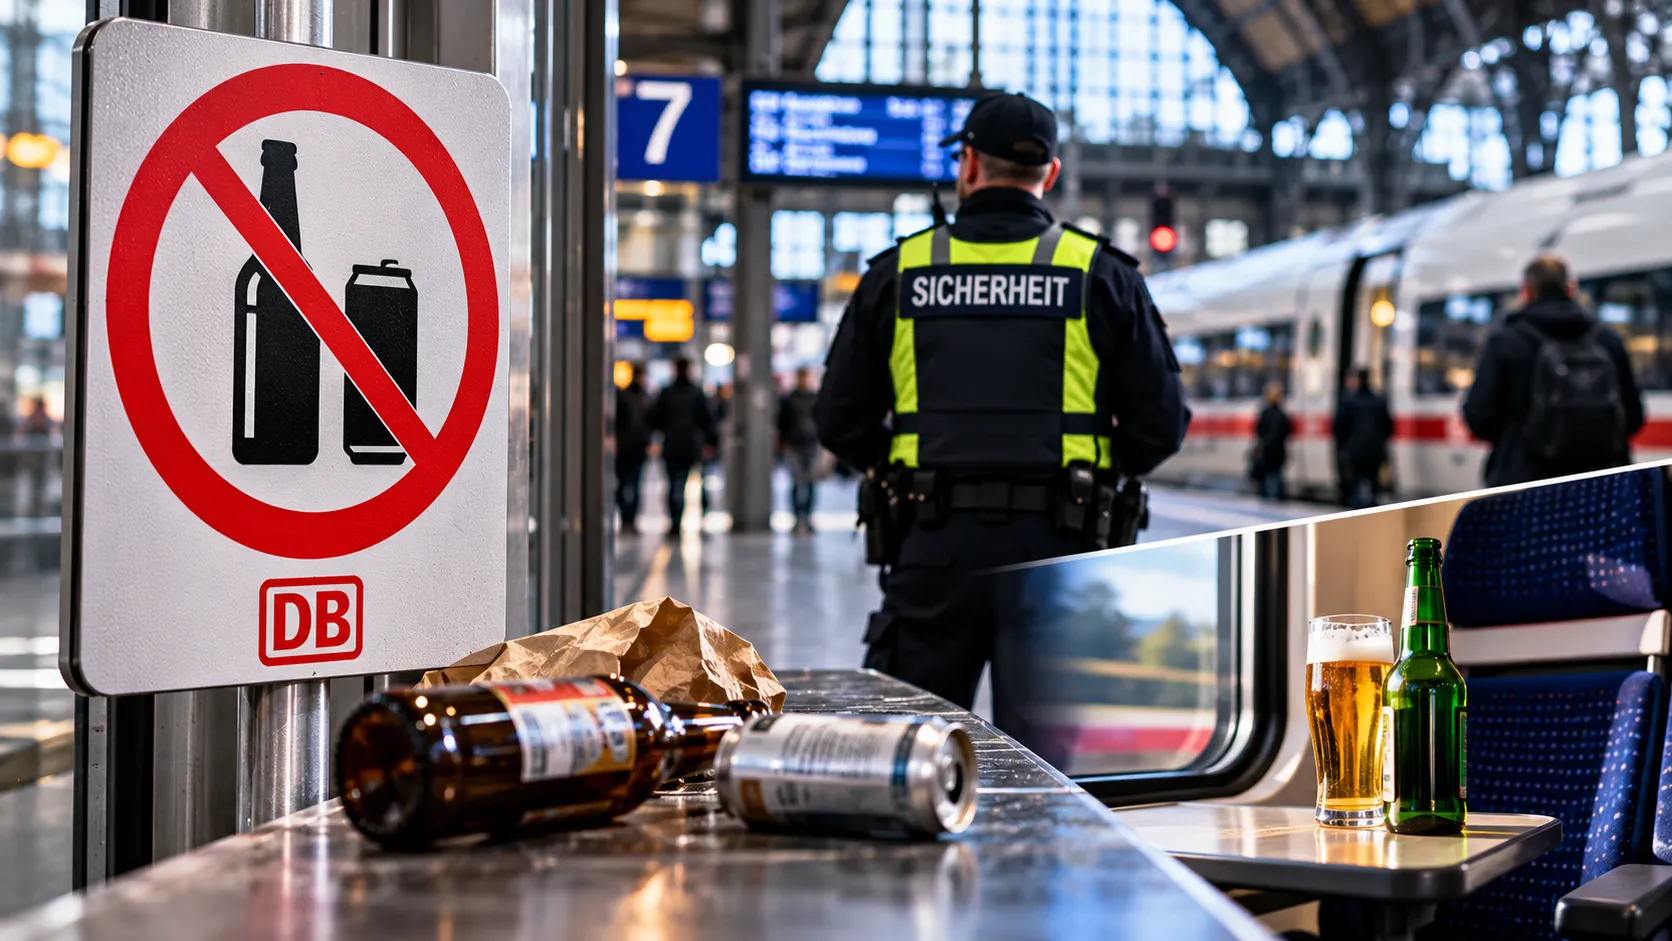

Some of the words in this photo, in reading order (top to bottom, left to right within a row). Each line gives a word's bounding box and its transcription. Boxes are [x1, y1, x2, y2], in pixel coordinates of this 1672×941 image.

[636, 81, 692, 165] 7
[911, 274, 1070, 307] SICHERHEIT
[273, 590, 351, 651] DB
